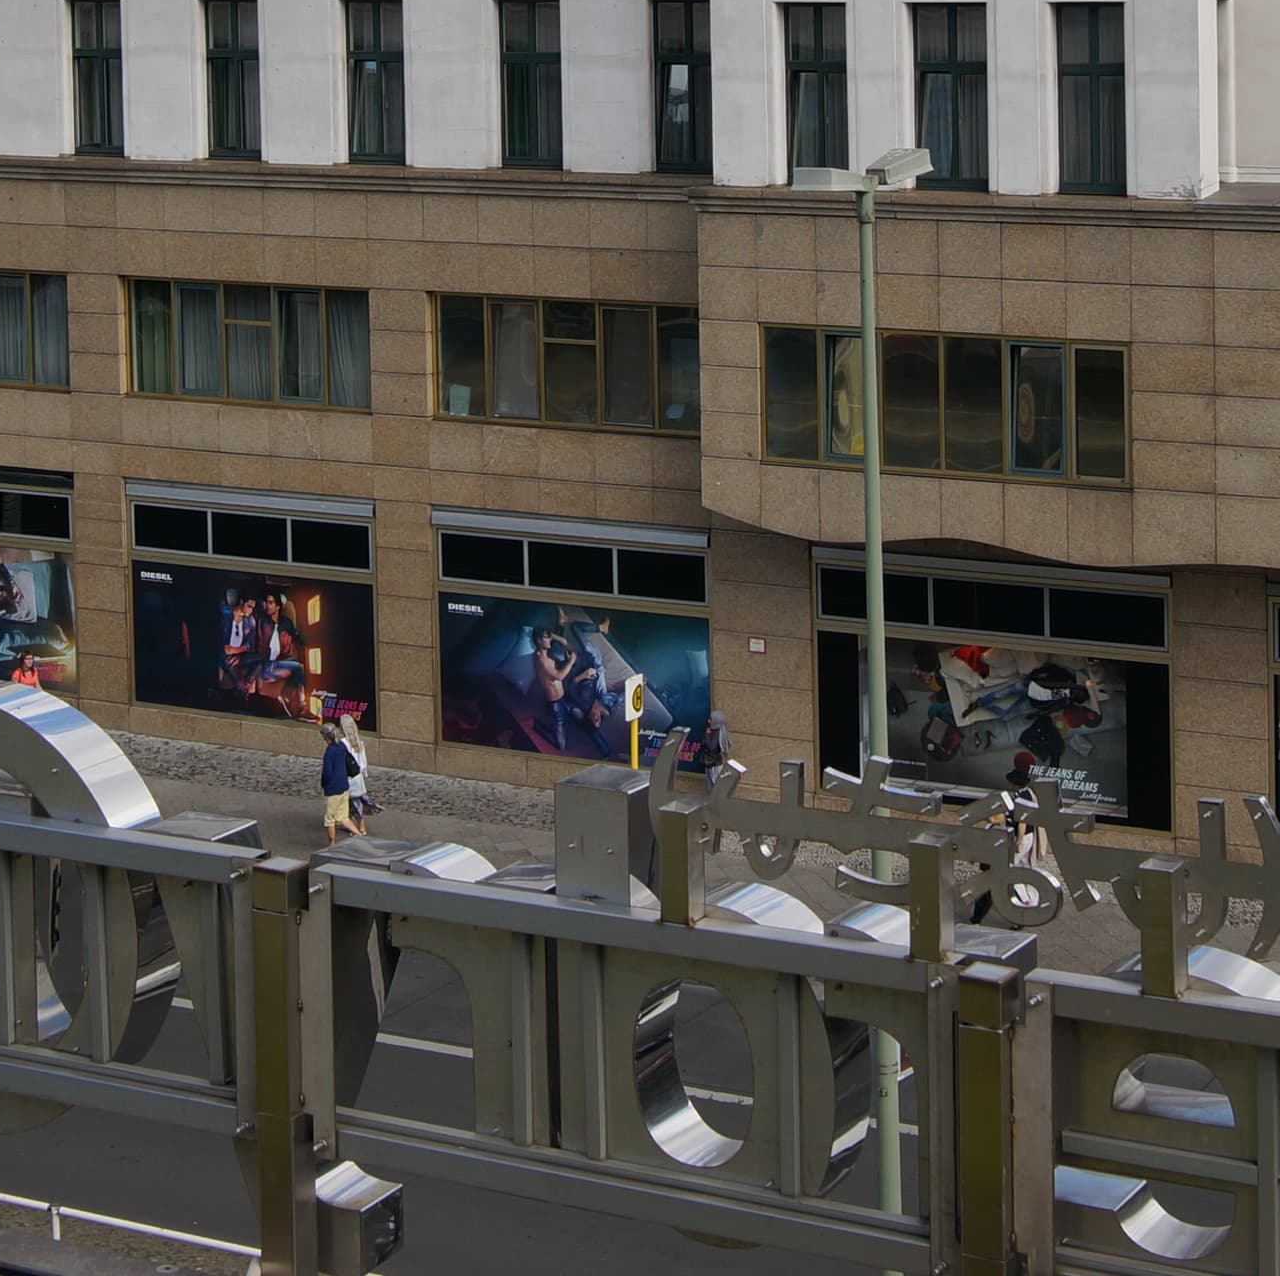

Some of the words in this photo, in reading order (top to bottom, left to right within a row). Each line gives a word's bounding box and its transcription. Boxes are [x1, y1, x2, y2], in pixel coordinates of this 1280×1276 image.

[140, 571, 173, 581] DIESEL
[447, 602, 484, 613] DIESEL
[1028, 764, 1046, 776] THE
[1045, 767, 1074, 779] JEANS
[1074, 770, 1088, 781] OF
[1061, 779, 1099, 793] DREAMS
